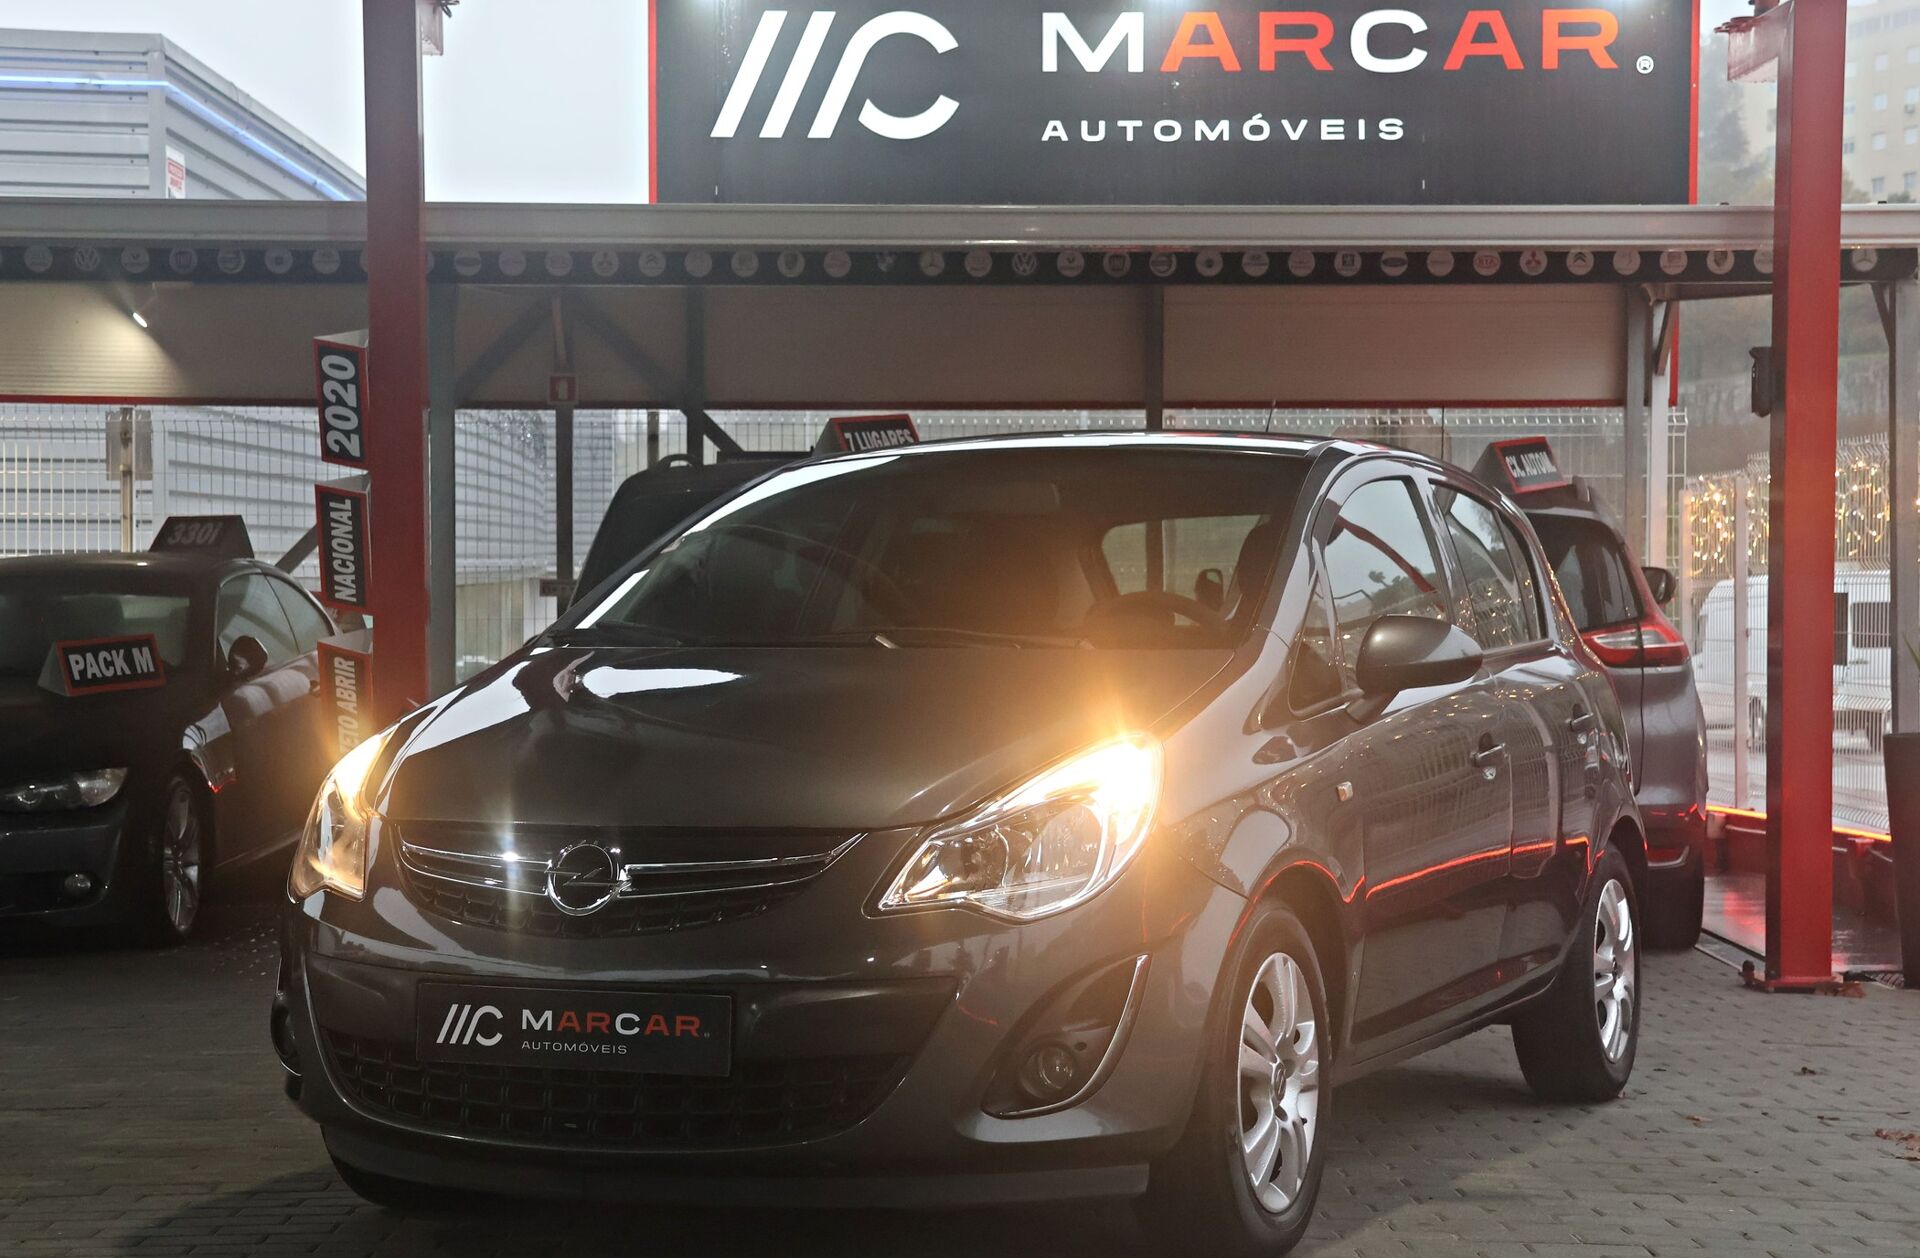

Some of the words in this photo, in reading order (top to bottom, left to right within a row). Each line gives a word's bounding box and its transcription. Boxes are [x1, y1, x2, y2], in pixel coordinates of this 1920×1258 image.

[1041, 9, 1618, 73] MARCAR
[1040, 113, 1406, 143] AUTOMÓVEIS
[321, 354, 361, 459] 2020
[844, 432, 856, 452] 7
[859, 428, 915, 450] LUGARES
[332, 498, 357, 602] NACIONAL
[68, 648, 131, 681] PACK
[133, 646, 155, 673] M
[333, 656, 358, 714] ABRIR
[521, 1009, 701, 1037] MARCAR
[521, 1039, 628, 1055] AUTOMÓVEIS
